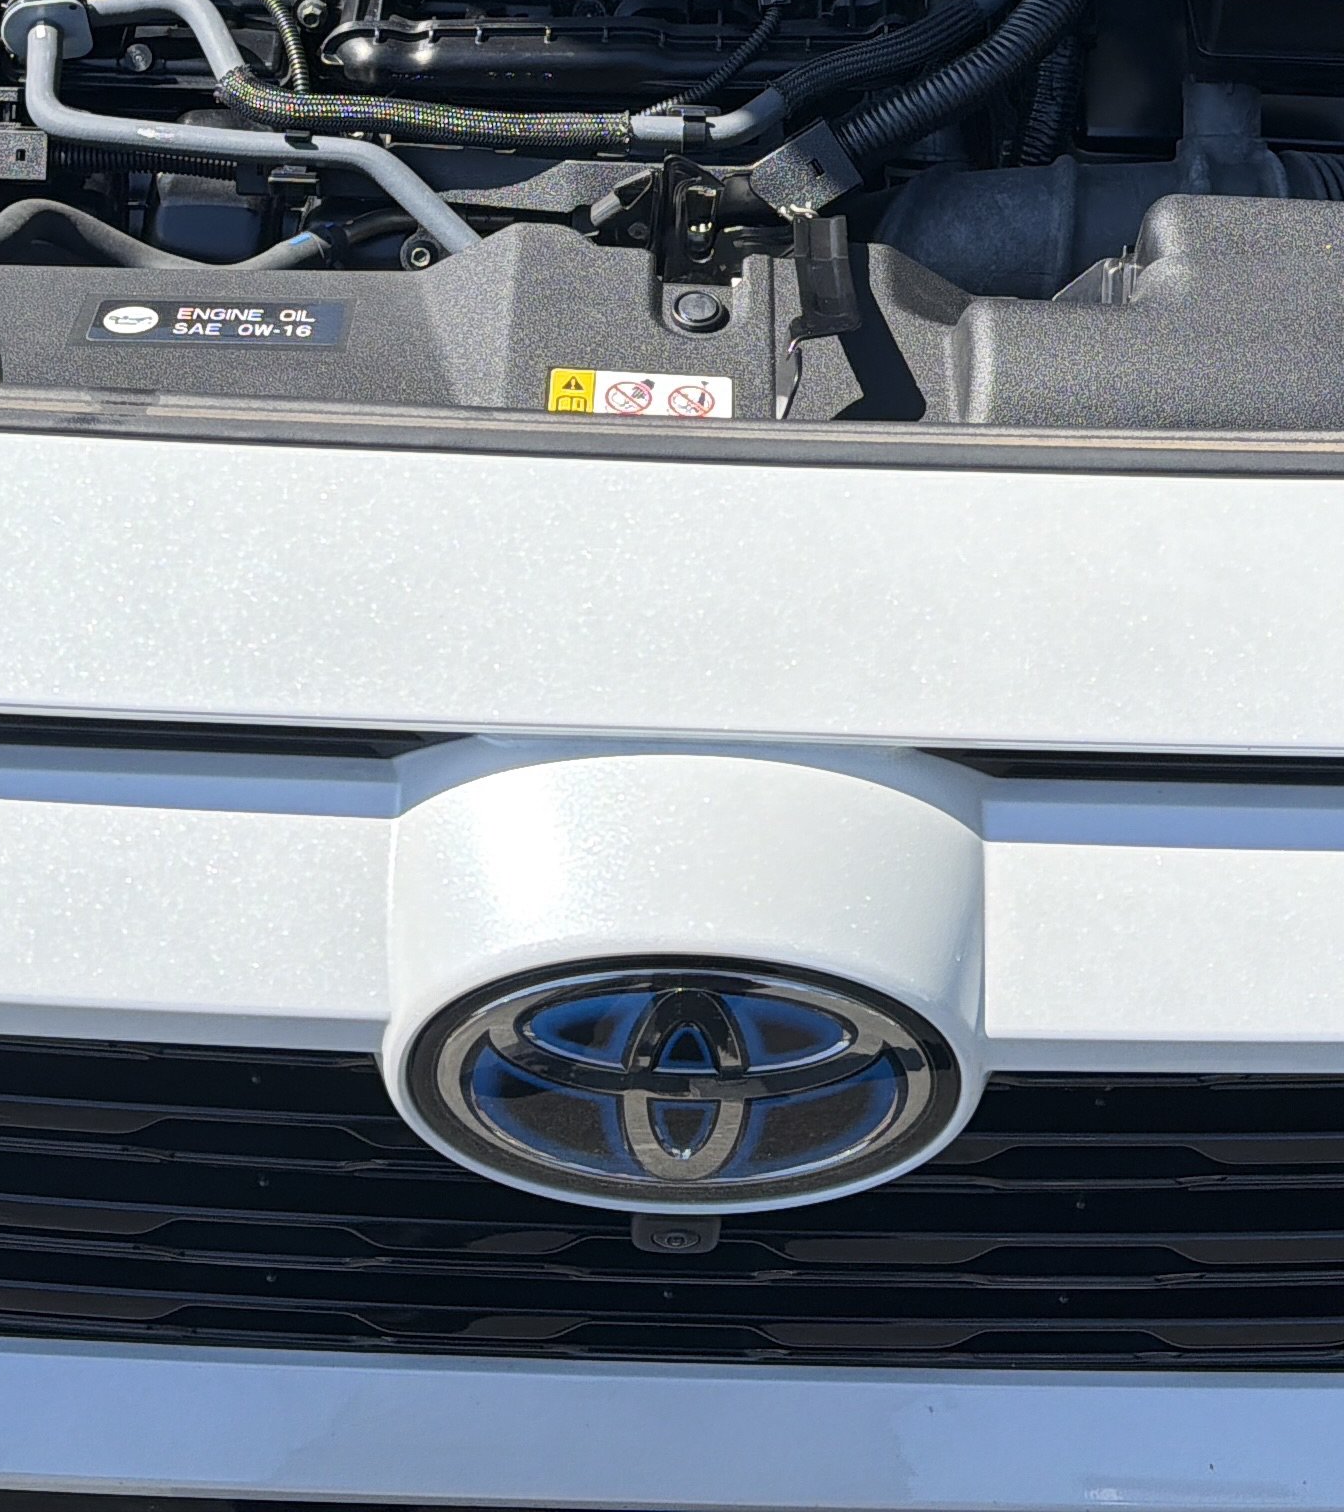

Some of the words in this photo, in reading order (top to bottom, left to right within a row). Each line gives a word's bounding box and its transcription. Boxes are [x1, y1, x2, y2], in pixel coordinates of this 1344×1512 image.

[176, 307, 265, 322] ENGINE
[279, 309, 316, 323] OIL
[172, 323, 222, 336] SAE
